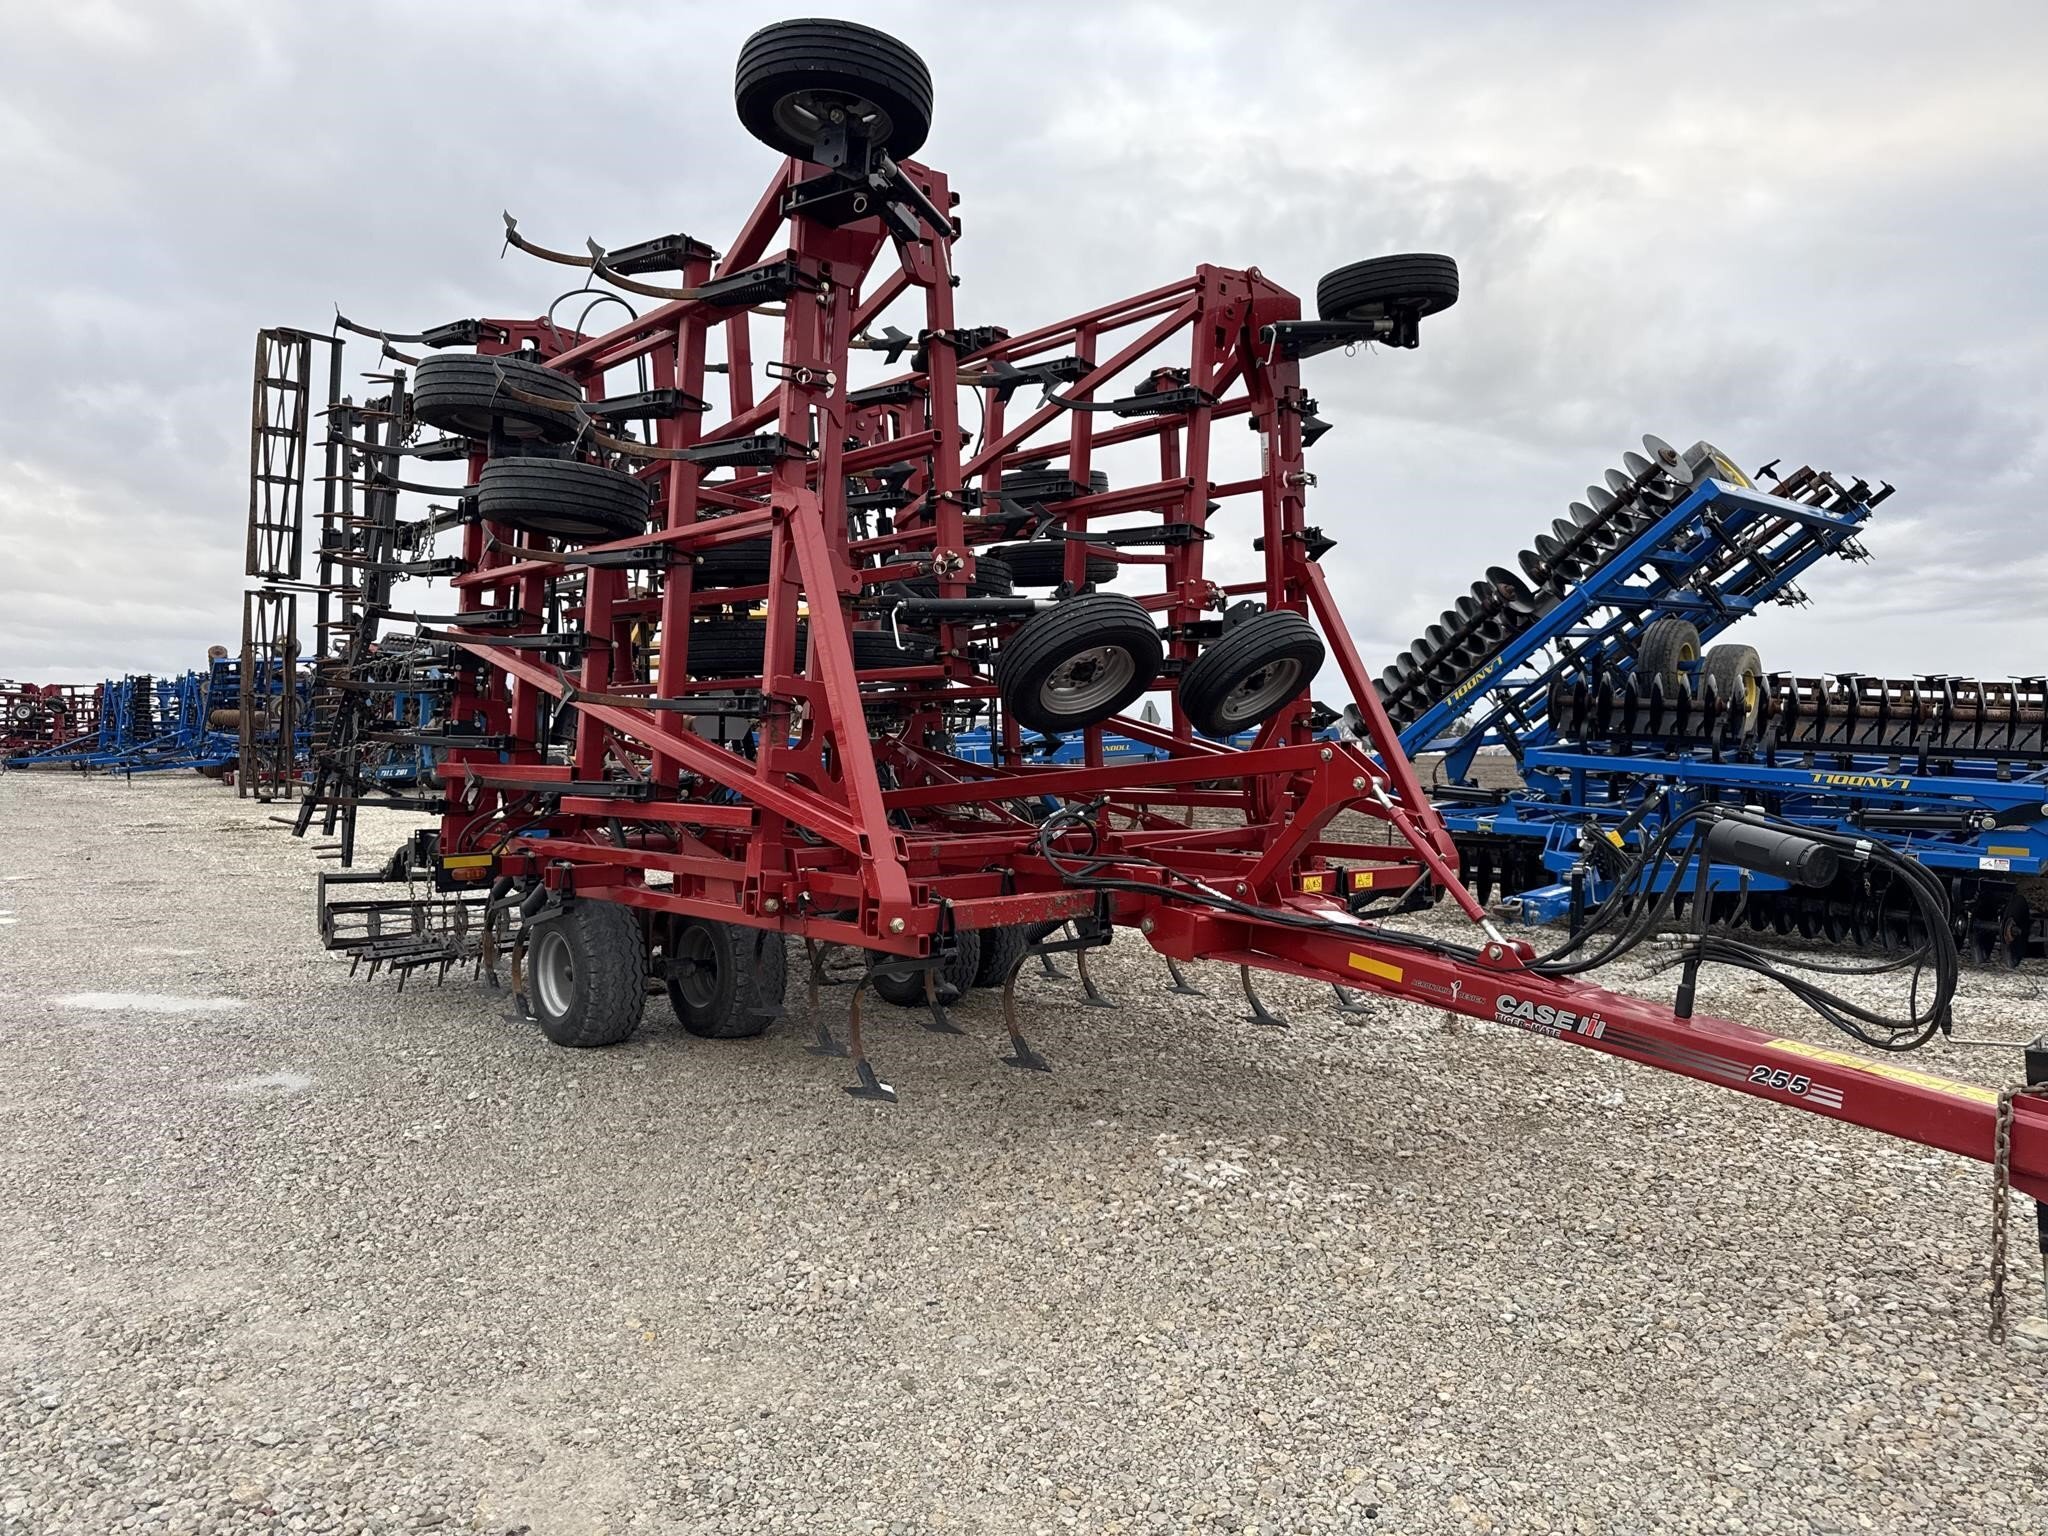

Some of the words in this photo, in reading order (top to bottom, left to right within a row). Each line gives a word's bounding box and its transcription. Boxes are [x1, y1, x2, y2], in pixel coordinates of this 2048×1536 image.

[1102, 744, 1130, 752] NDOLL
[1810, 773, 1910, 789] LANDOLL
[1456, 990, 1487, 1005] DESIGN
[1495, 994, 1577, 1031] CASE
[1748, 1064, 1811, 1096] 255
